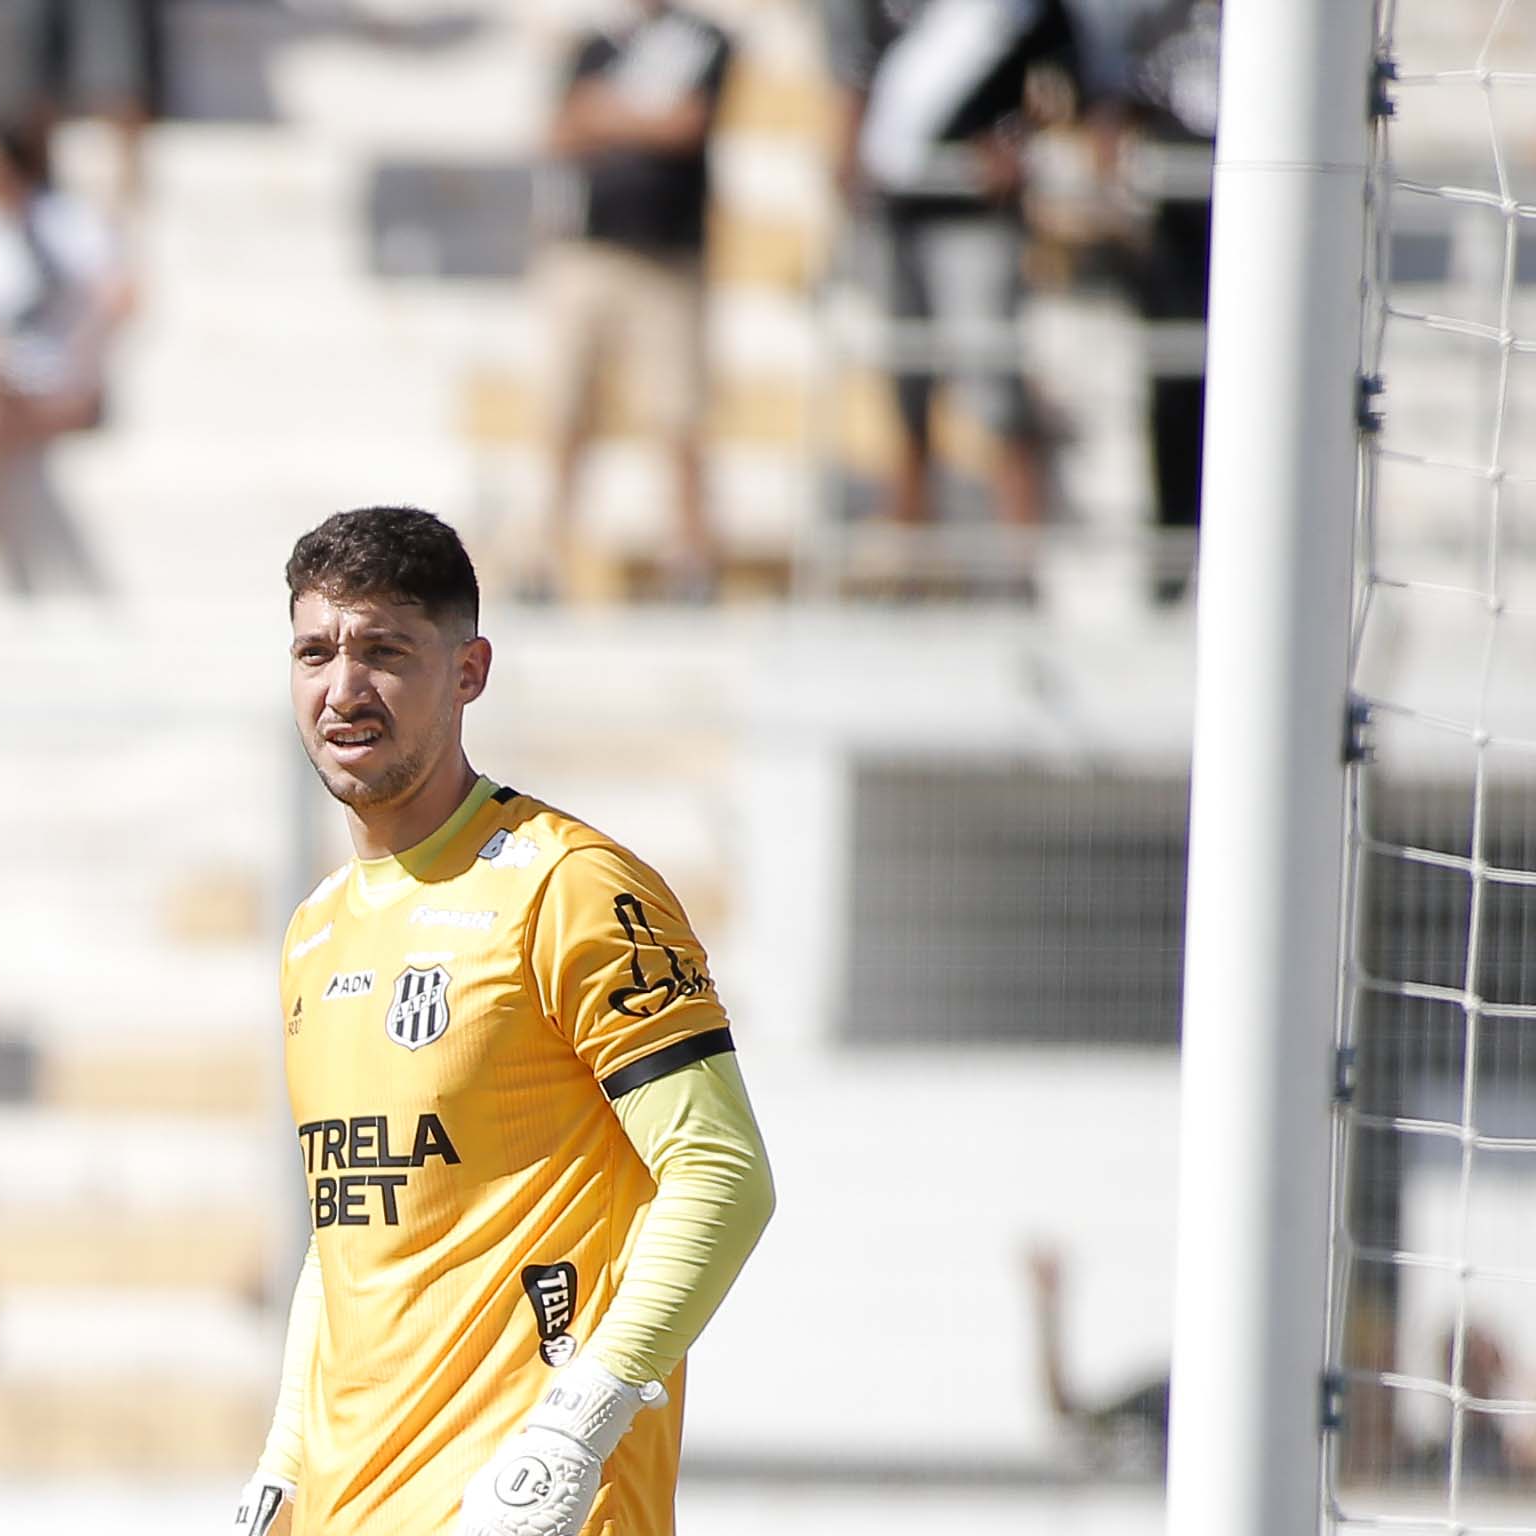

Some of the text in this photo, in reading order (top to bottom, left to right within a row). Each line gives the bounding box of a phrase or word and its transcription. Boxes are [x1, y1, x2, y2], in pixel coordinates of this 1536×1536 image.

[299, 1113, 461, 1174] TRELA
[316, 1174, 408, 1229] BET
[537, 1270, 570, 1334] TELE
